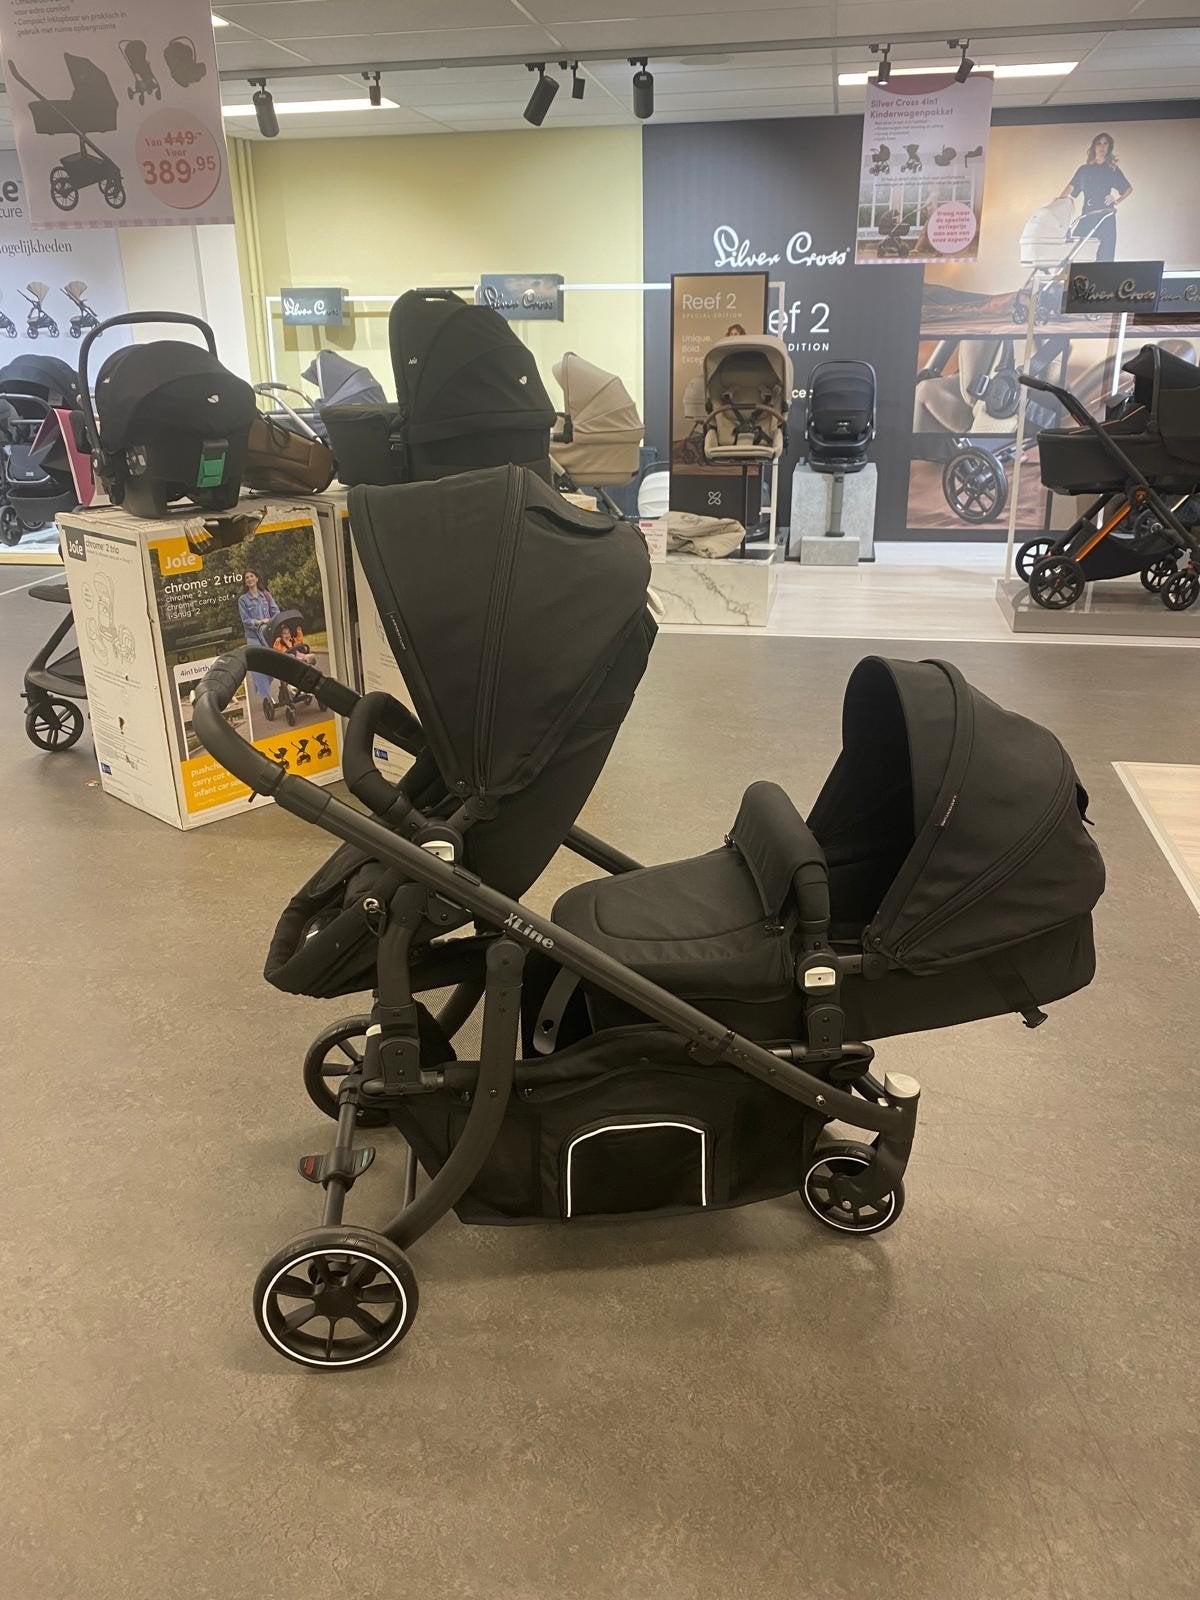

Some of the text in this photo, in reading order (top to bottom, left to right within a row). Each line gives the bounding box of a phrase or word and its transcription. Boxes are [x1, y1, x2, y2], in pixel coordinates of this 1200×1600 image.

[871, 100, 893, 108] Silver
[896, 98, 919, 106] Cross
[0, 239, 72, 256] ogelijkheden
[713, 225, 848, 267] Silver Cross
[682, 292, 736, 310] Reef 2
[769, 301, 830, 334] ef 2
[788, 343, 830, 352] DITION
[69, 540, 83, 556] Joie
[165, 551, 196, 569] Joie
[213, 575, 221, 586] 2
[223, 572, 243, 584] trio
[219, 594, 230, 602] cot
